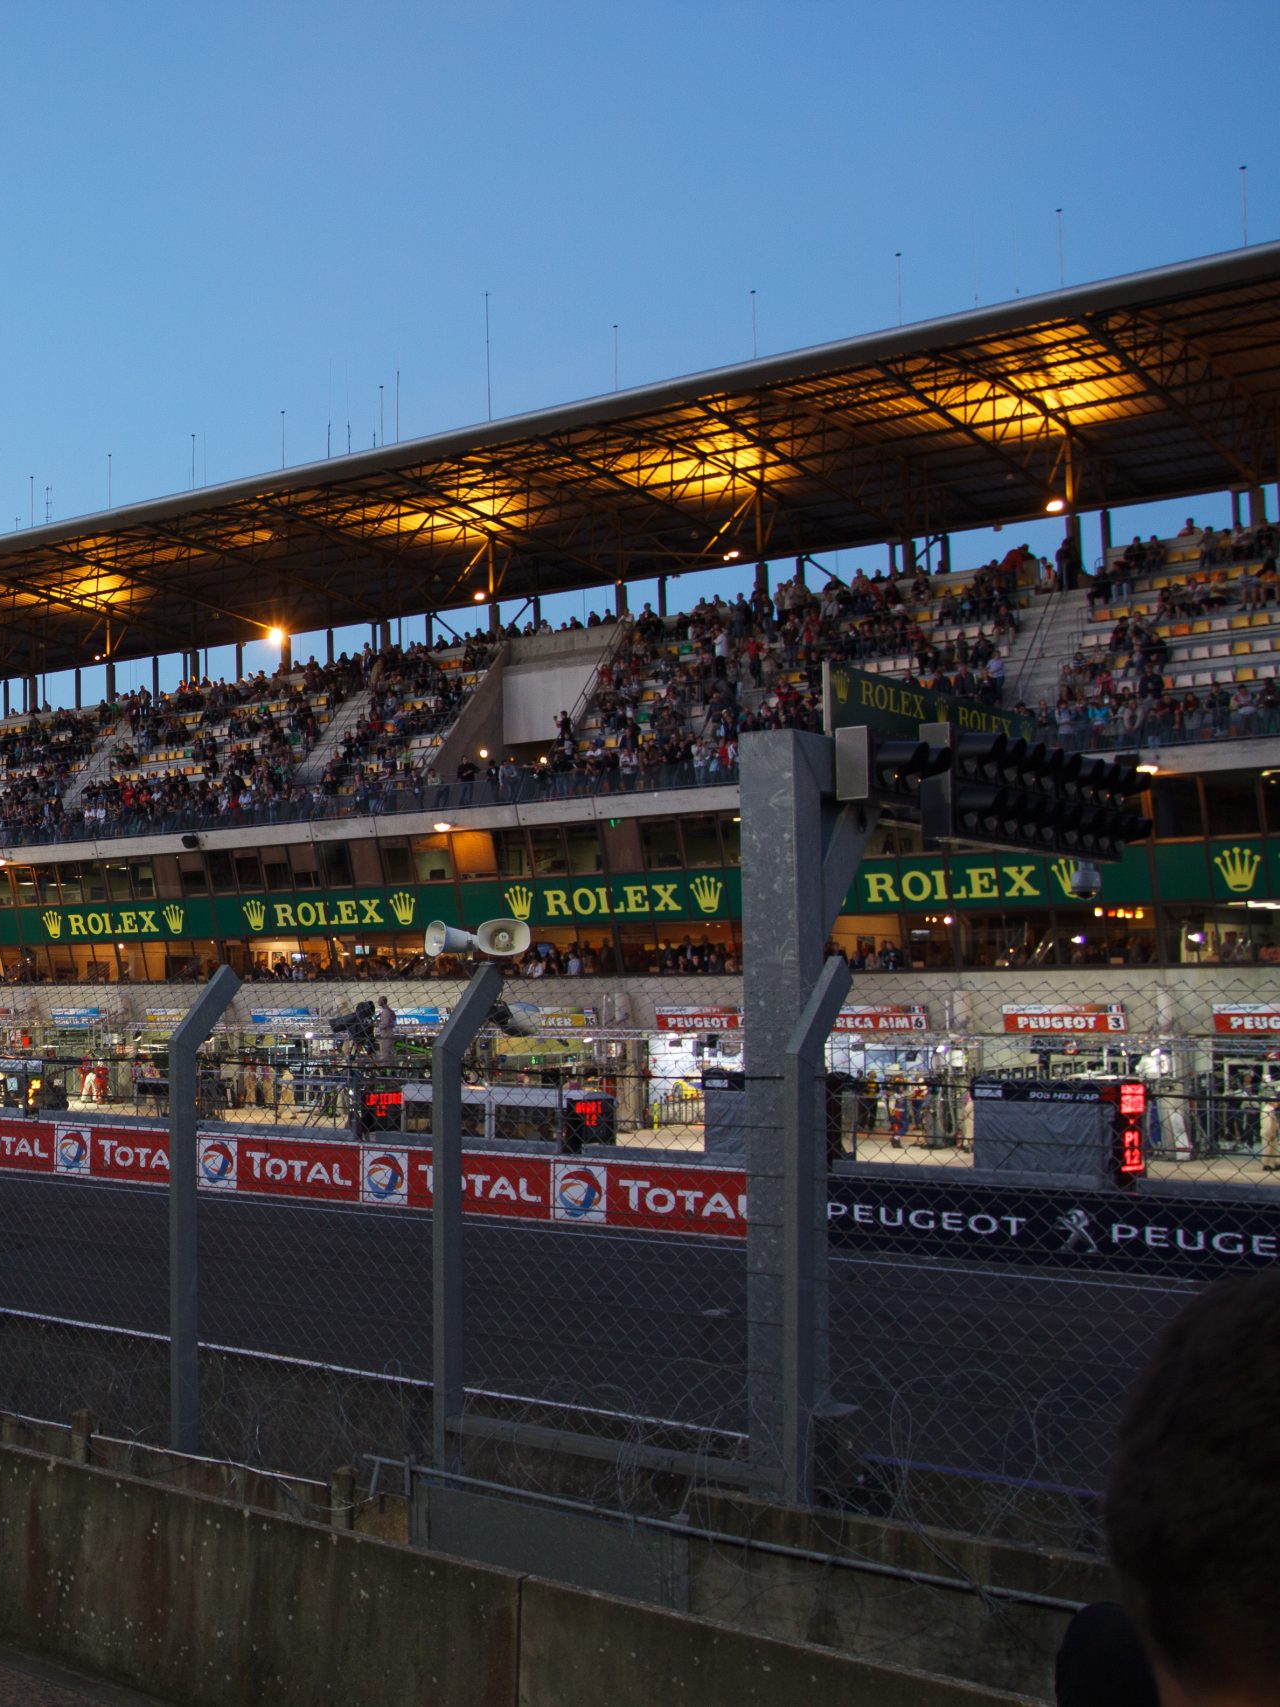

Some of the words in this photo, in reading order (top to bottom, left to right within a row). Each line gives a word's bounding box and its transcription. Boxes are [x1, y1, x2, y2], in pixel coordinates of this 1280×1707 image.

[860, 679, 926, 721] ROLEX
[958, 706, 1012, 737] ROLEX
[864, 864, 1041, 903] ROLEX
[274, 898, 384, 928] ROLEX
[543, 883, 682, 917] ROLEX
[67, 910, 159, 936] ROLEX
[541, 1017, 572, 1026] YKER
[667, 1017, 729, 1028] PEUGEOT
[832, 1017, 874, 1029] RECA
[879, 1017, 910, 1029] AIM
[915, 1017, 923, 1028] 6
[1017, 1016, 1096, 1029] PEUGEOT
[1111, 1017, 1121, 1029] 3
[1230, 1016, 1280, 1029] PEUG
[98, 1138, 170, 1171] TOTA
[1124, 1131, 1139, 1148] P1
[246, 1151, 352, 1187] TOTAL
[418, 1164, 542, 1203] TTAL
[618, 1179, 746, 1220] TOTA
[827, 1202, 1027, 1237] PEUGEOT
[1111, 1222, 1279, 1259] PEUGE
